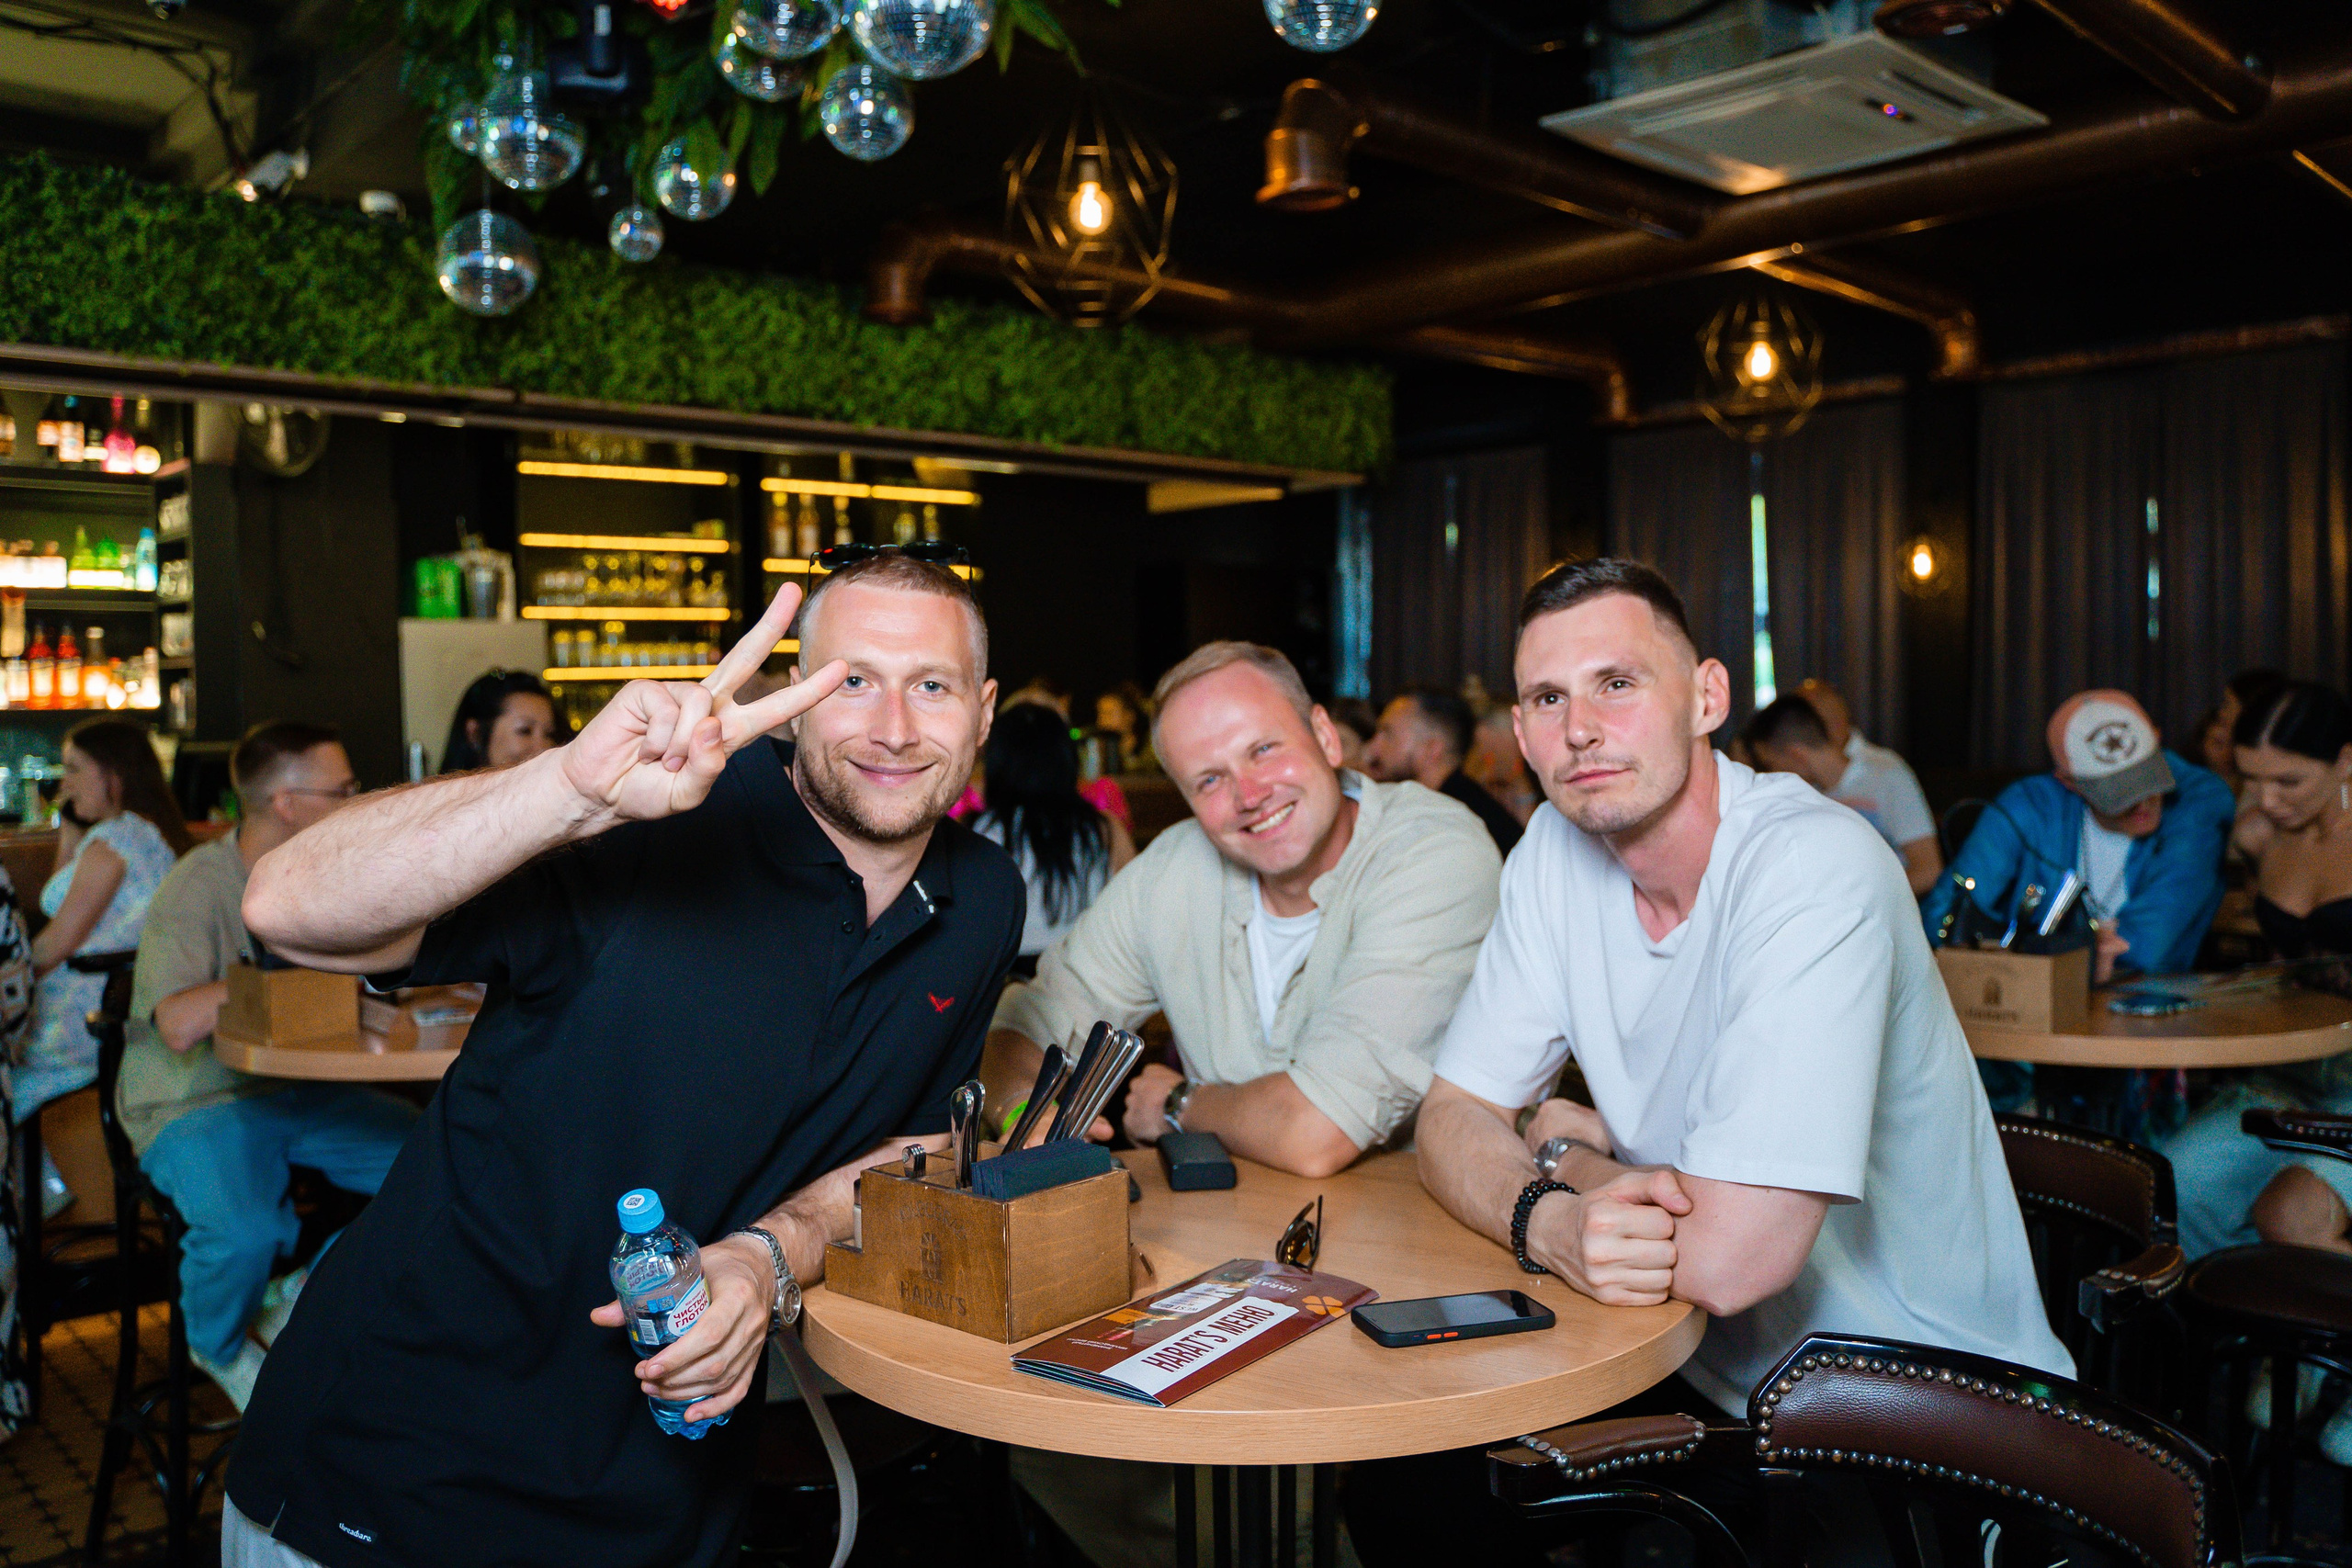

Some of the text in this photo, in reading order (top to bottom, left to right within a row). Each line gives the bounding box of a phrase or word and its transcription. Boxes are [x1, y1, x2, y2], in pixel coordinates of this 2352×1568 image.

[673, 1290, 706, 1319] ЧИСТЫЙ
[675, 1296, 708, 1328] ГЛОТОК
[1140, 1305, 1275, 1373] HARAT'S МЕНЮ
